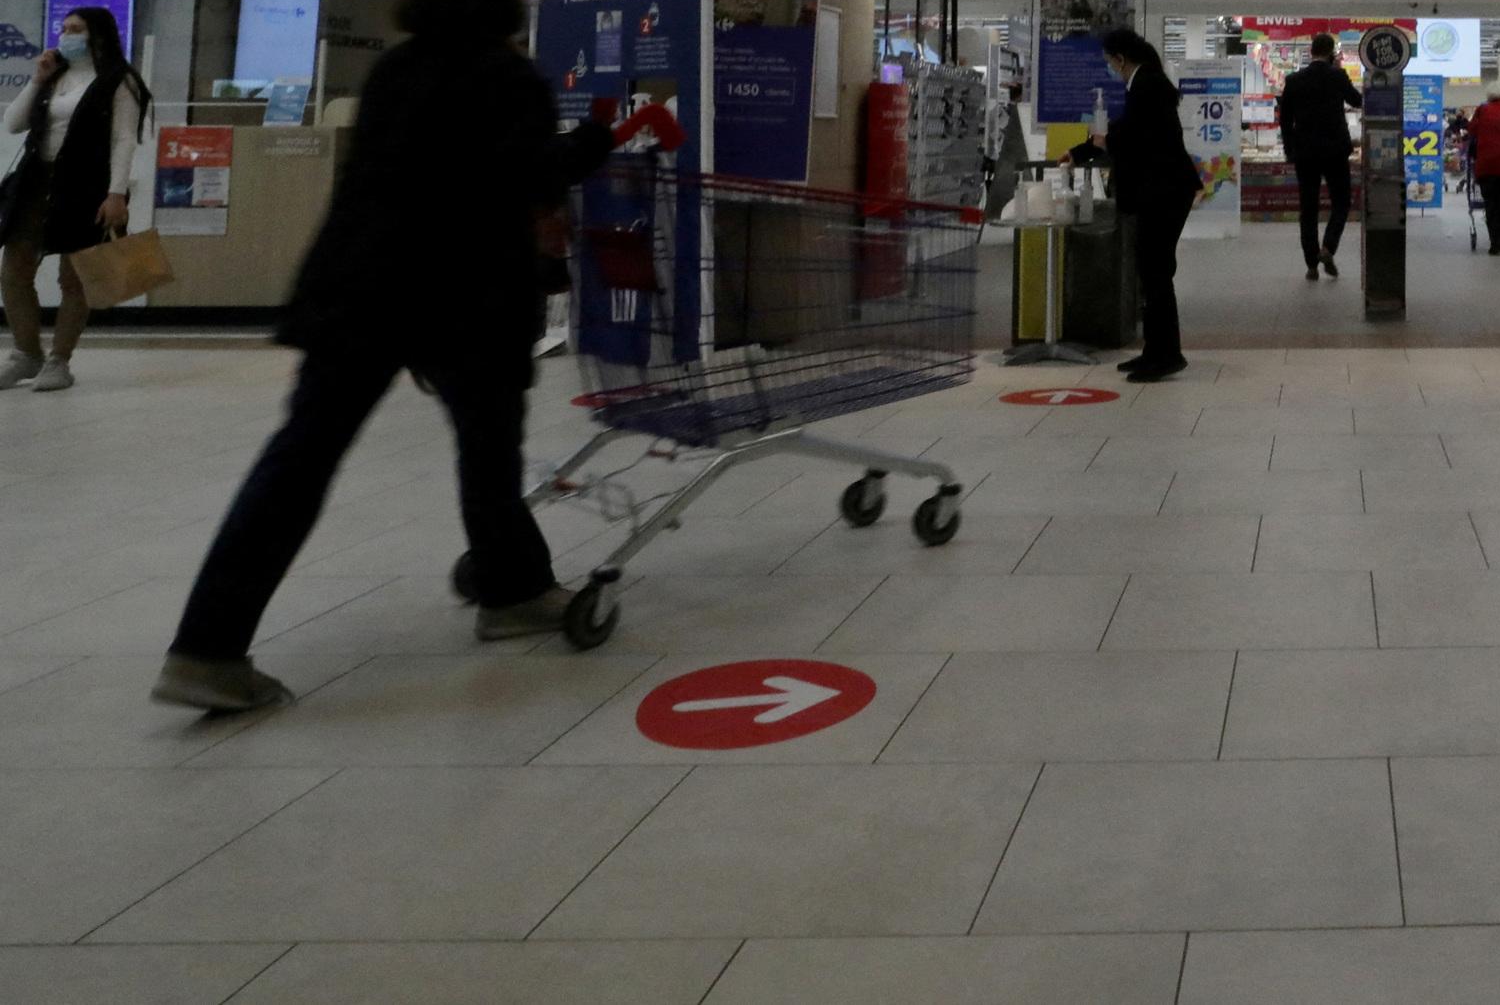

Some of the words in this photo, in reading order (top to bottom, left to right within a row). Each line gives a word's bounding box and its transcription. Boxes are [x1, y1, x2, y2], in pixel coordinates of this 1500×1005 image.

[642, 20, 649, 32] 2
[567, 74, 574, 87] 1
[727, 83, 760, 97] 1450
[1403, 130, 1439, 156] x2
